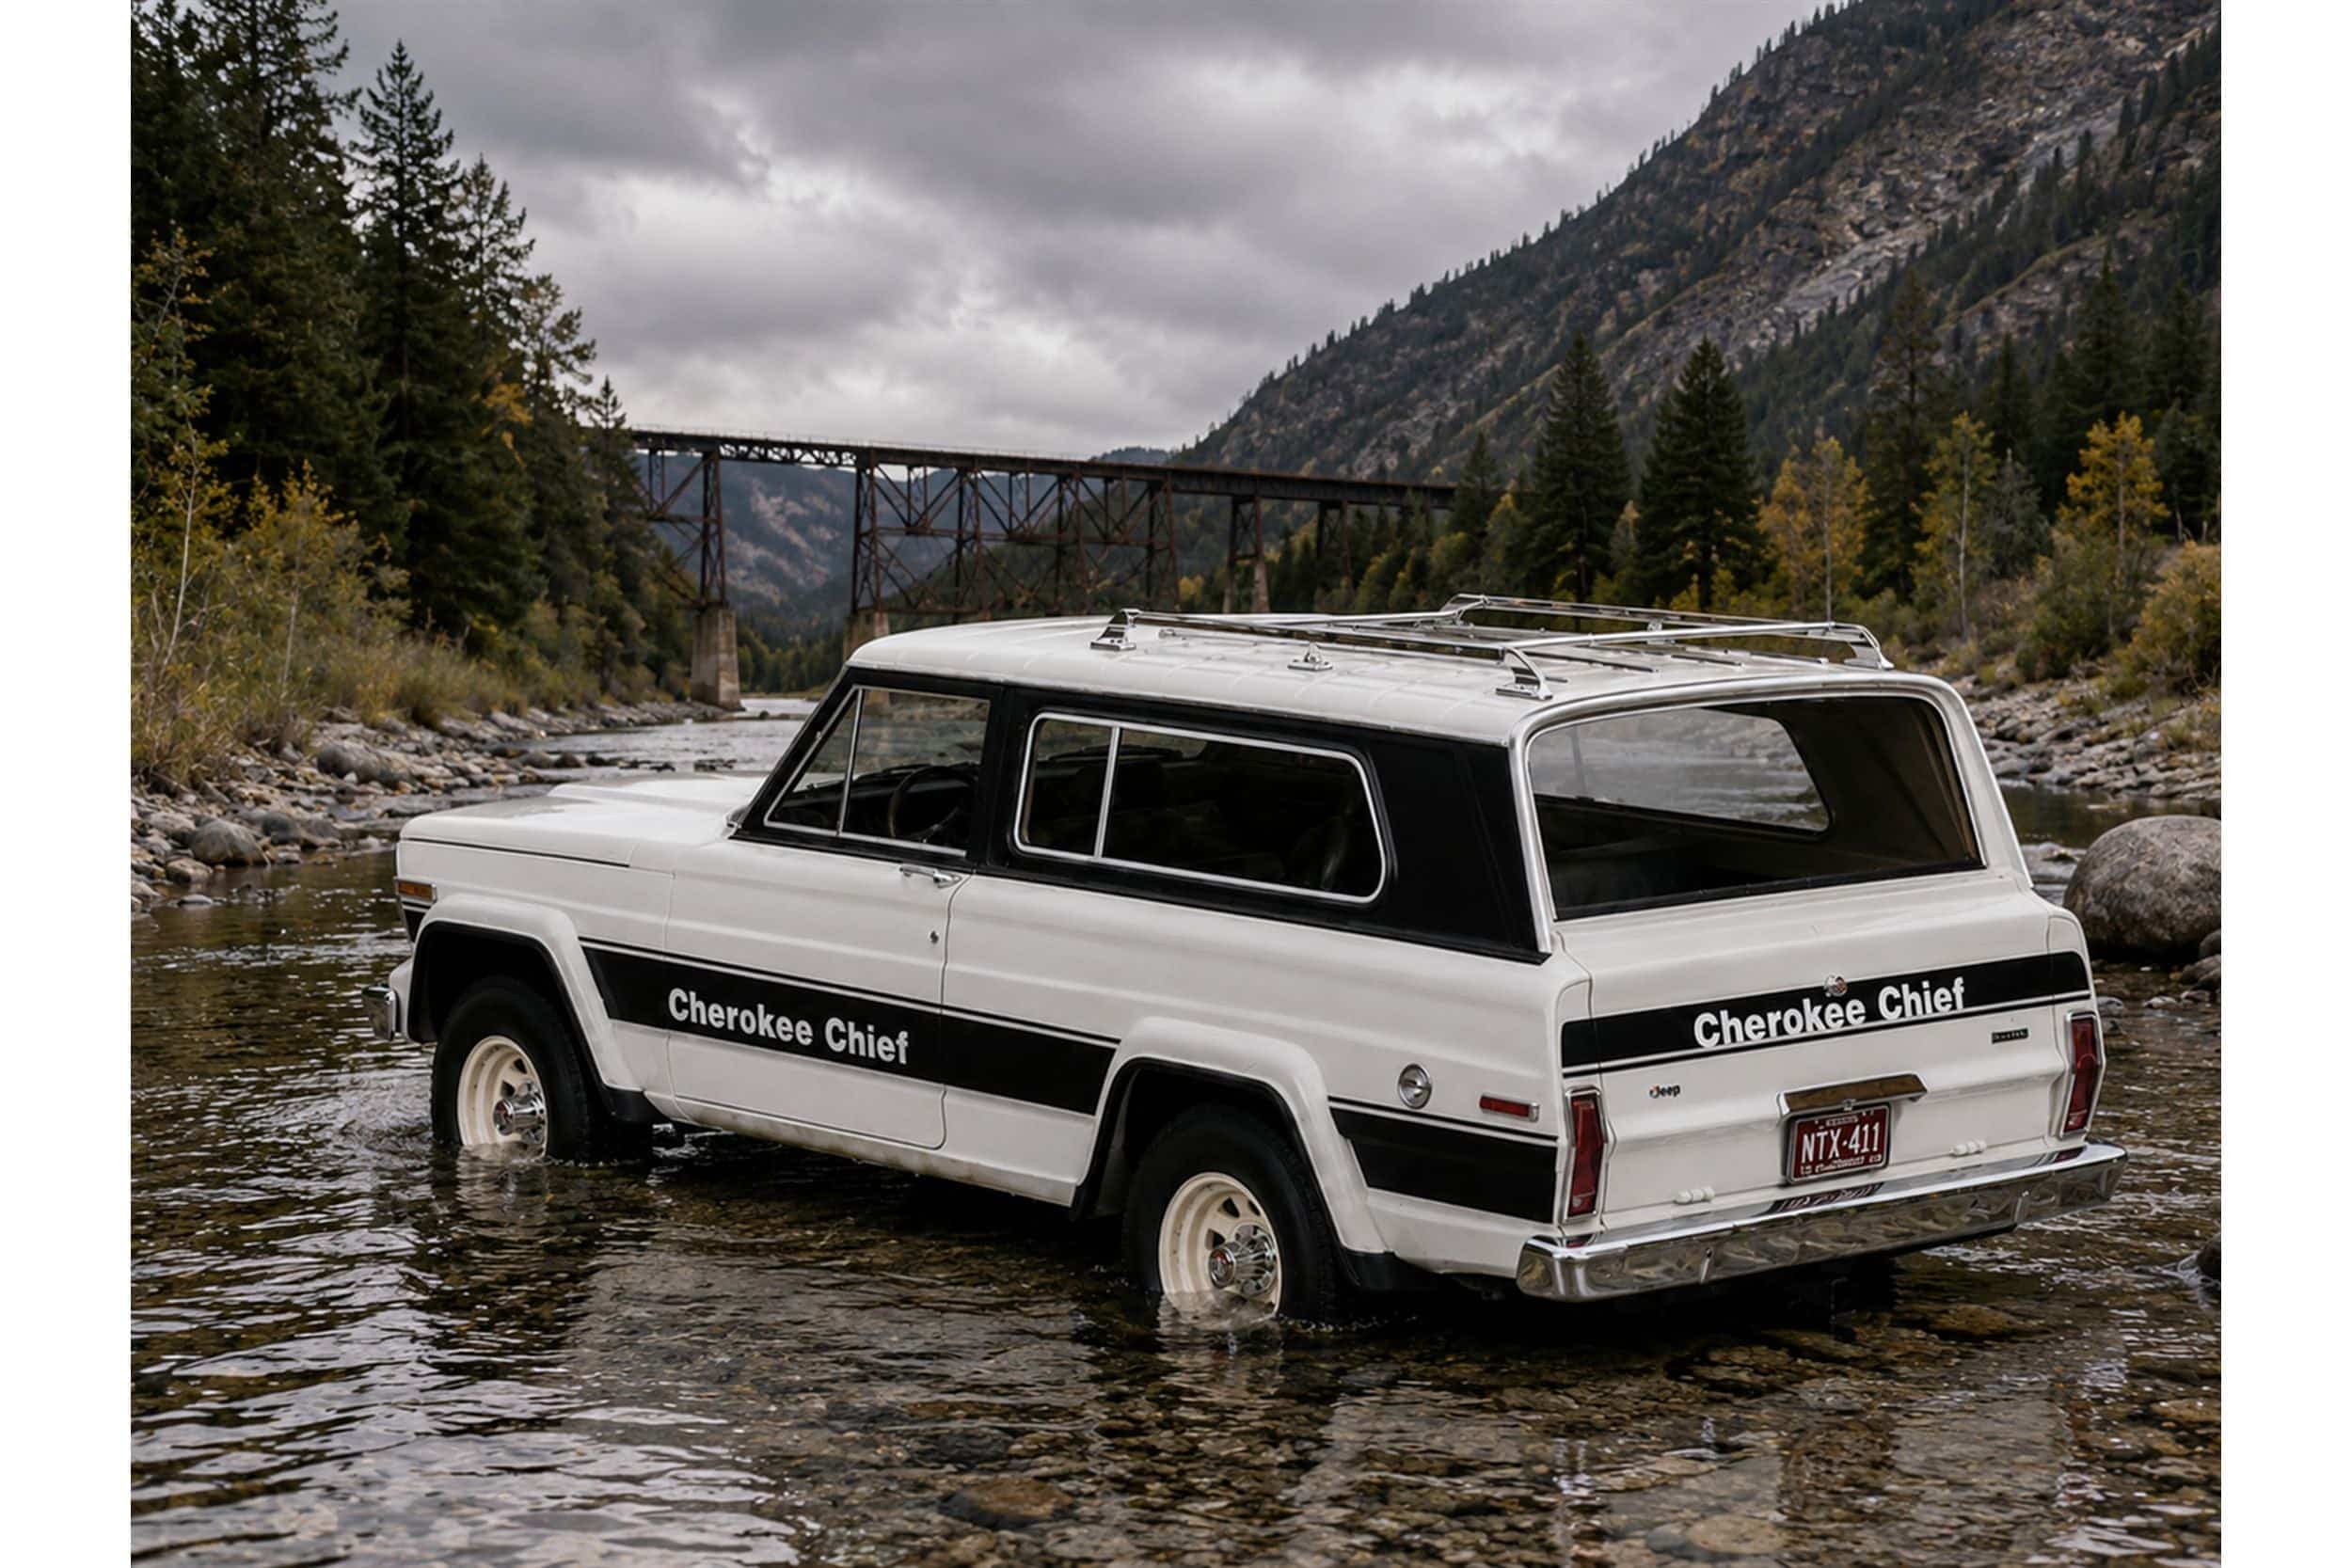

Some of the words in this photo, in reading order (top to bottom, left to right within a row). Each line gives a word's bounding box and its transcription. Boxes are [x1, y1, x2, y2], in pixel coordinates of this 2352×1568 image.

[668, 988, 813, 1046] Cherokee
[825, 1017, 909, 1065] Chief
[1694, 998, 1867, 1049] Cherokee
[1878, 976, 1965, 1021] Chief
[1648, 1084, 1681, 1100] Jeep
